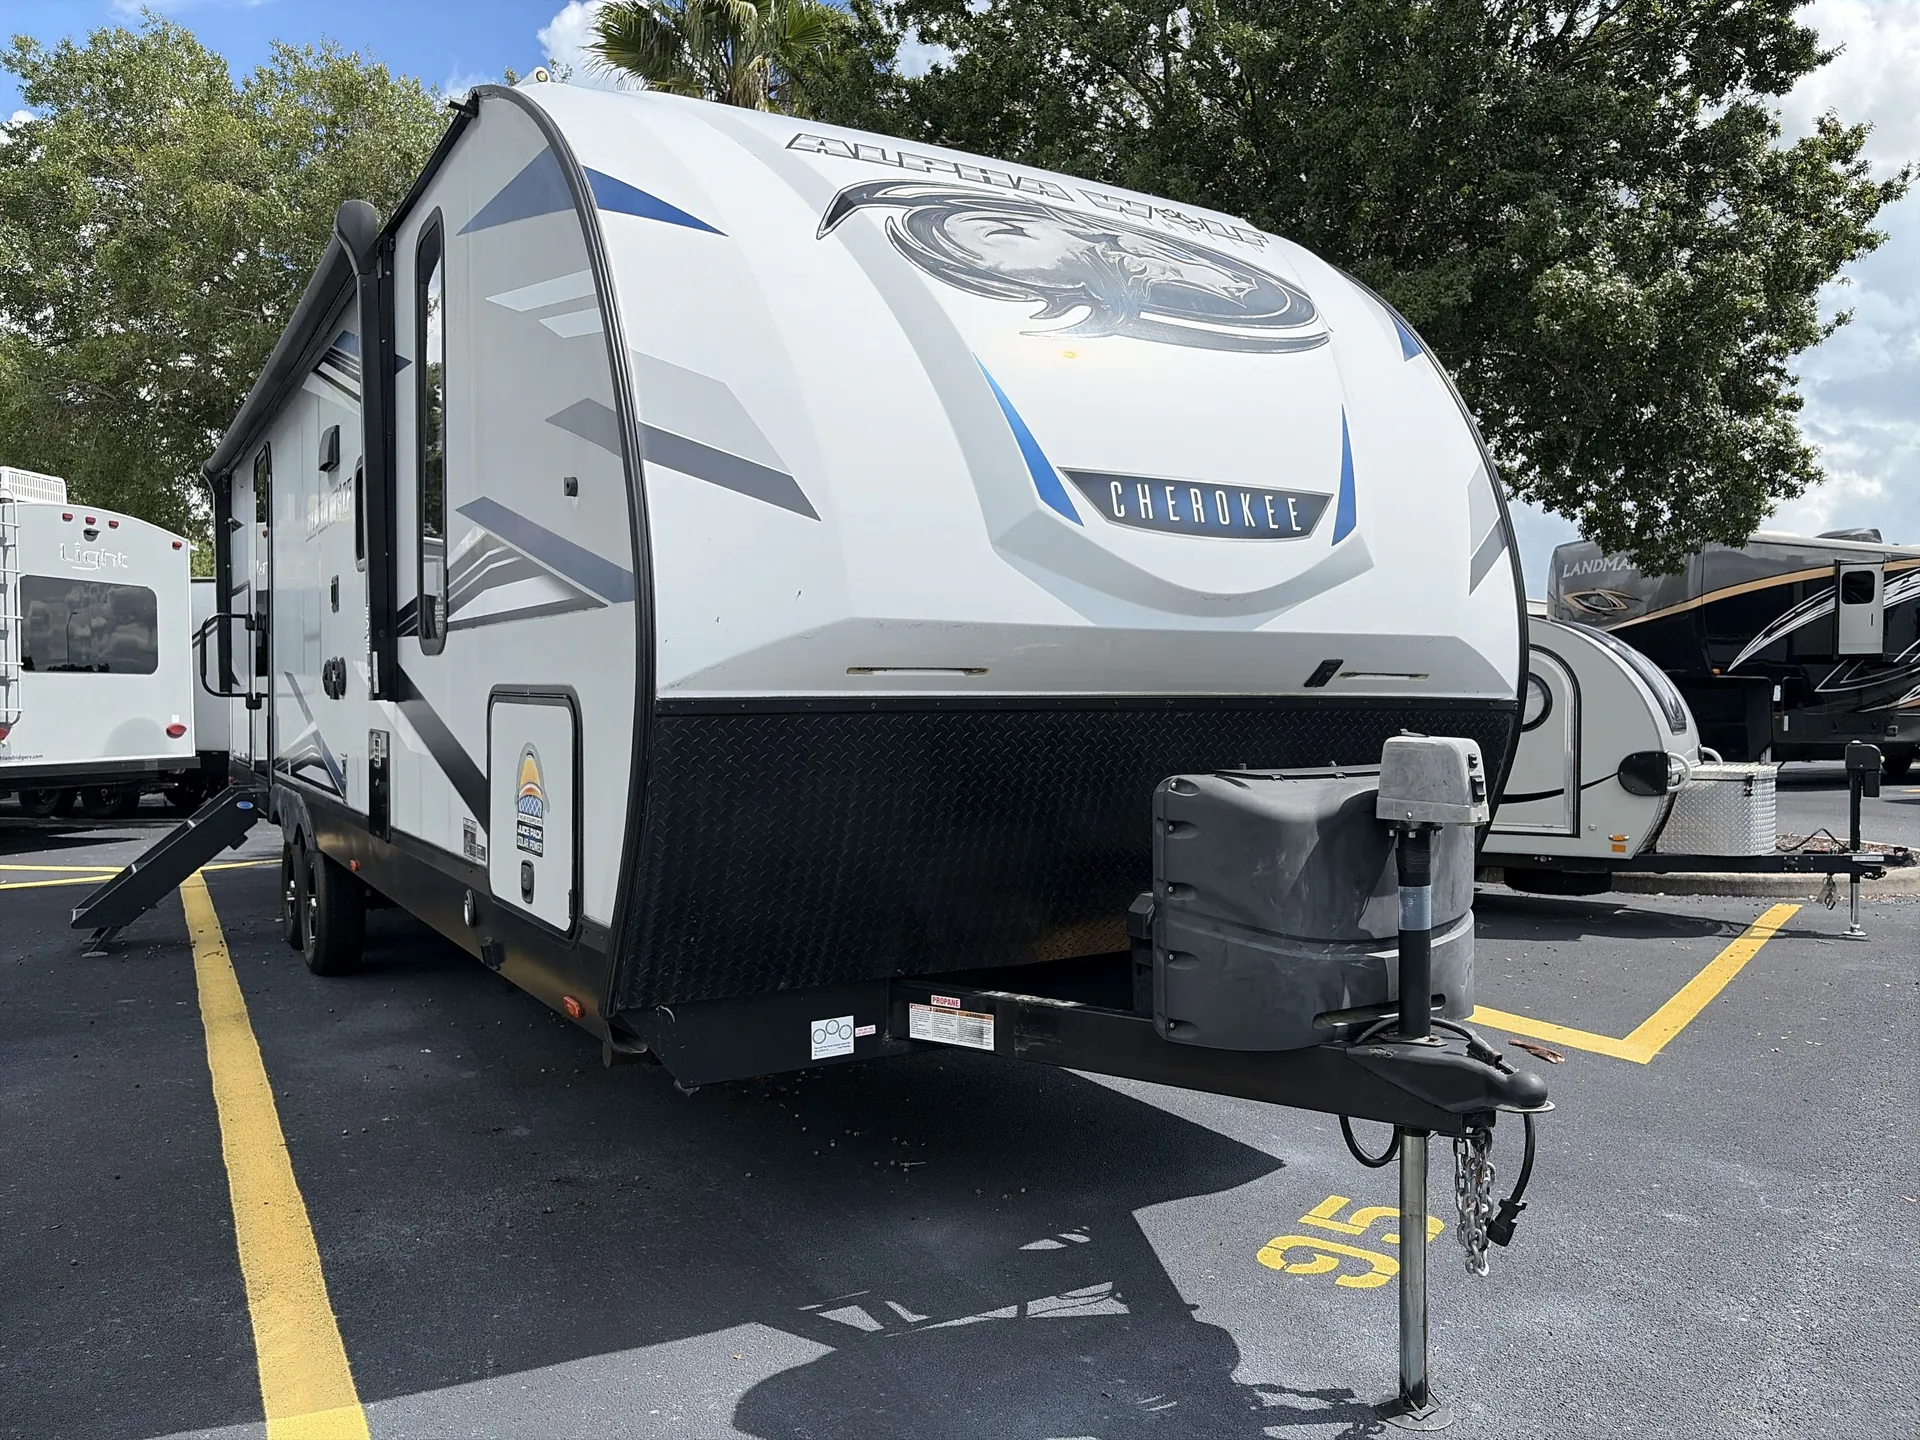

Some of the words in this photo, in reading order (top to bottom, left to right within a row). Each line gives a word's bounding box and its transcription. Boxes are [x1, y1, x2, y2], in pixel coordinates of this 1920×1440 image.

[785, 133, 1074, 202] ALPHA
[1109, 481, 1302, 532] CHEROKEE
[60, 541, 128, 571] Light
[1562, 557, 1638, 578] LANDMA
[932, 996, 959, 1007] PROPANE
[1256, 1195, 1445, 1288] 95
